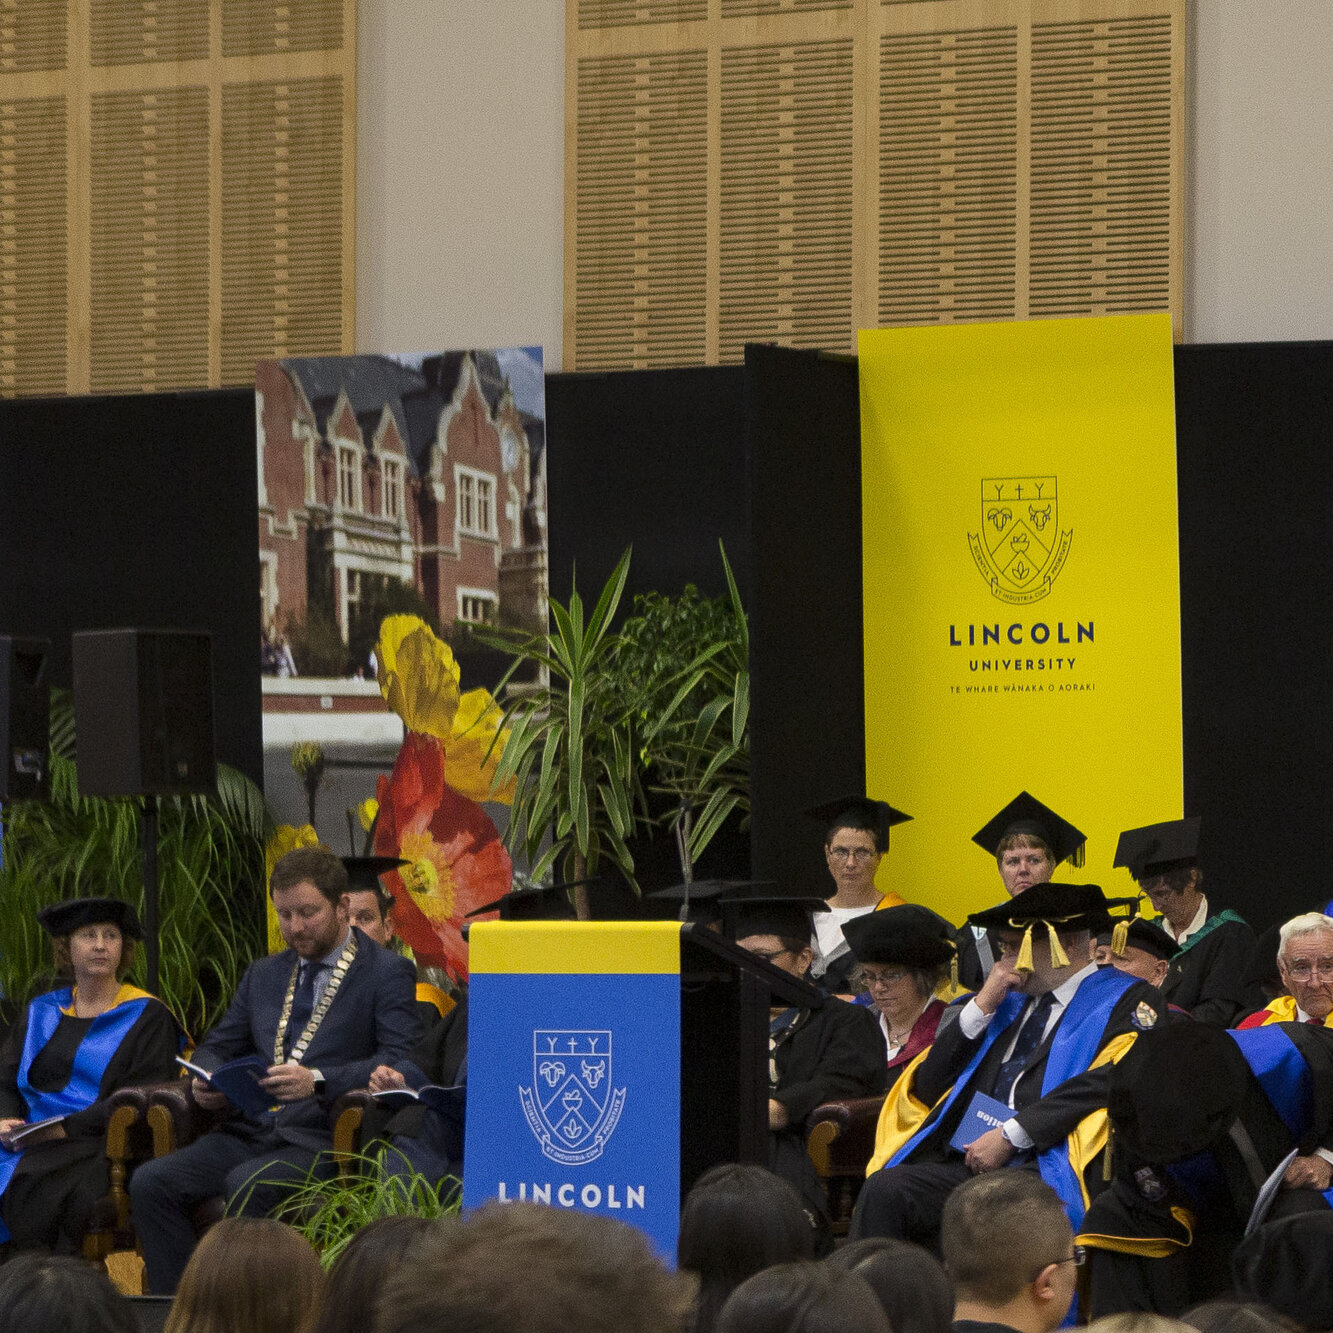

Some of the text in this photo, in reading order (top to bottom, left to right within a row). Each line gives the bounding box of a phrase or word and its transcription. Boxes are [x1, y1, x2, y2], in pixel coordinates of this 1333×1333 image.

[949, 621, 1095, 647] LINCOLN
[970, 658, 1076, 672] UNIVERSITY
[950, 686, 961, 694] TE
[966, 684, 999, 693] WHARE
[1058, 683, 1096, 692] AORAKI
[976, 1110, 1004, 1128] ation
[498, 1182, 645, 1209] LINCOLN
